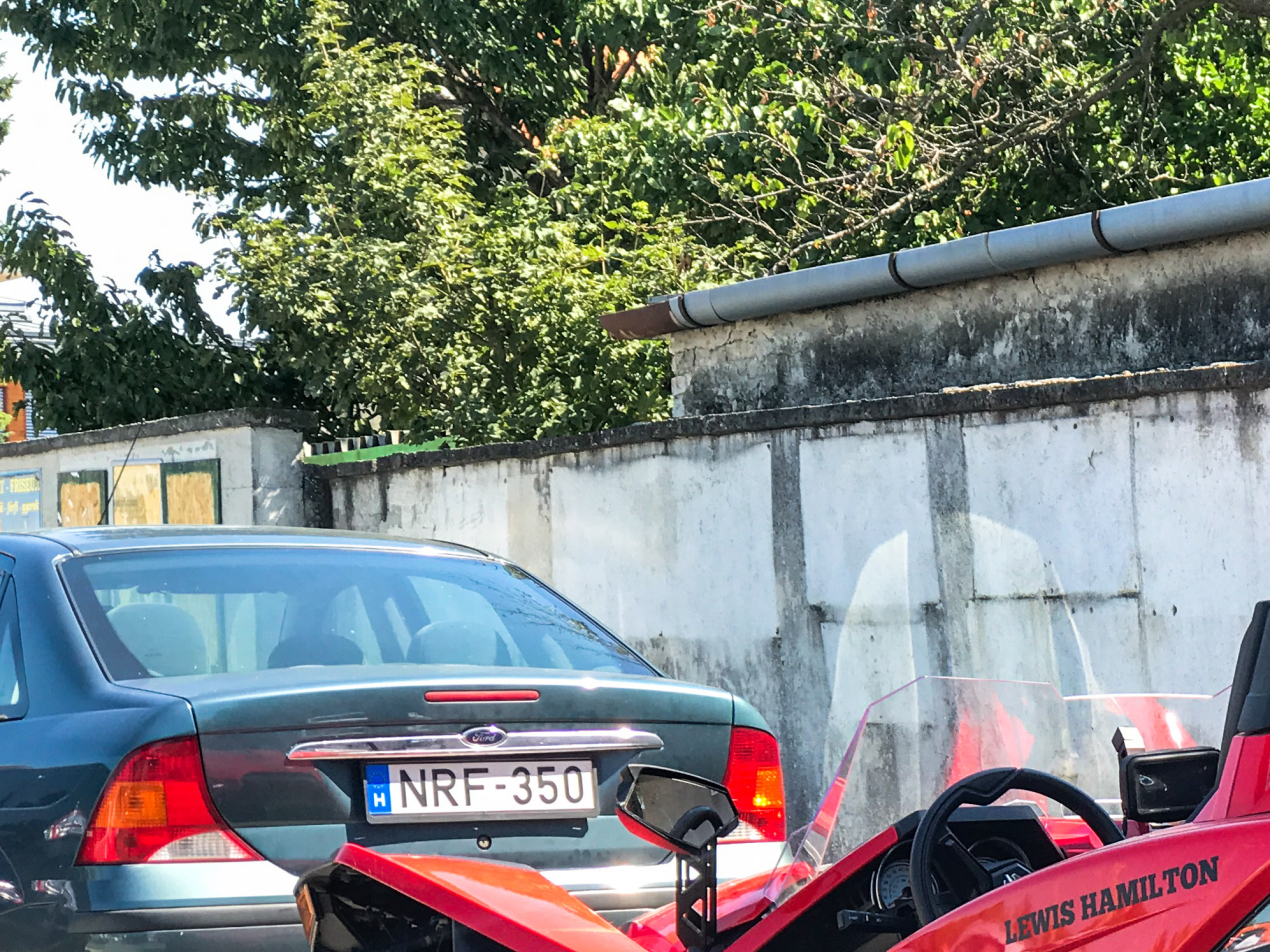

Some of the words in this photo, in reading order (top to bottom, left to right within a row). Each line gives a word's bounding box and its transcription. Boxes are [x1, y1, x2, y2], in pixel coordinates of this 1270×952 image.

[472, 731, 496, 742] Ford
[373, 792, 387, 808] H
[400, 765, 584, 808] NRF-350
[1004, 899, 1075, 944] LEWIS
[1080, 856, 1219, 921] HAMILTON
